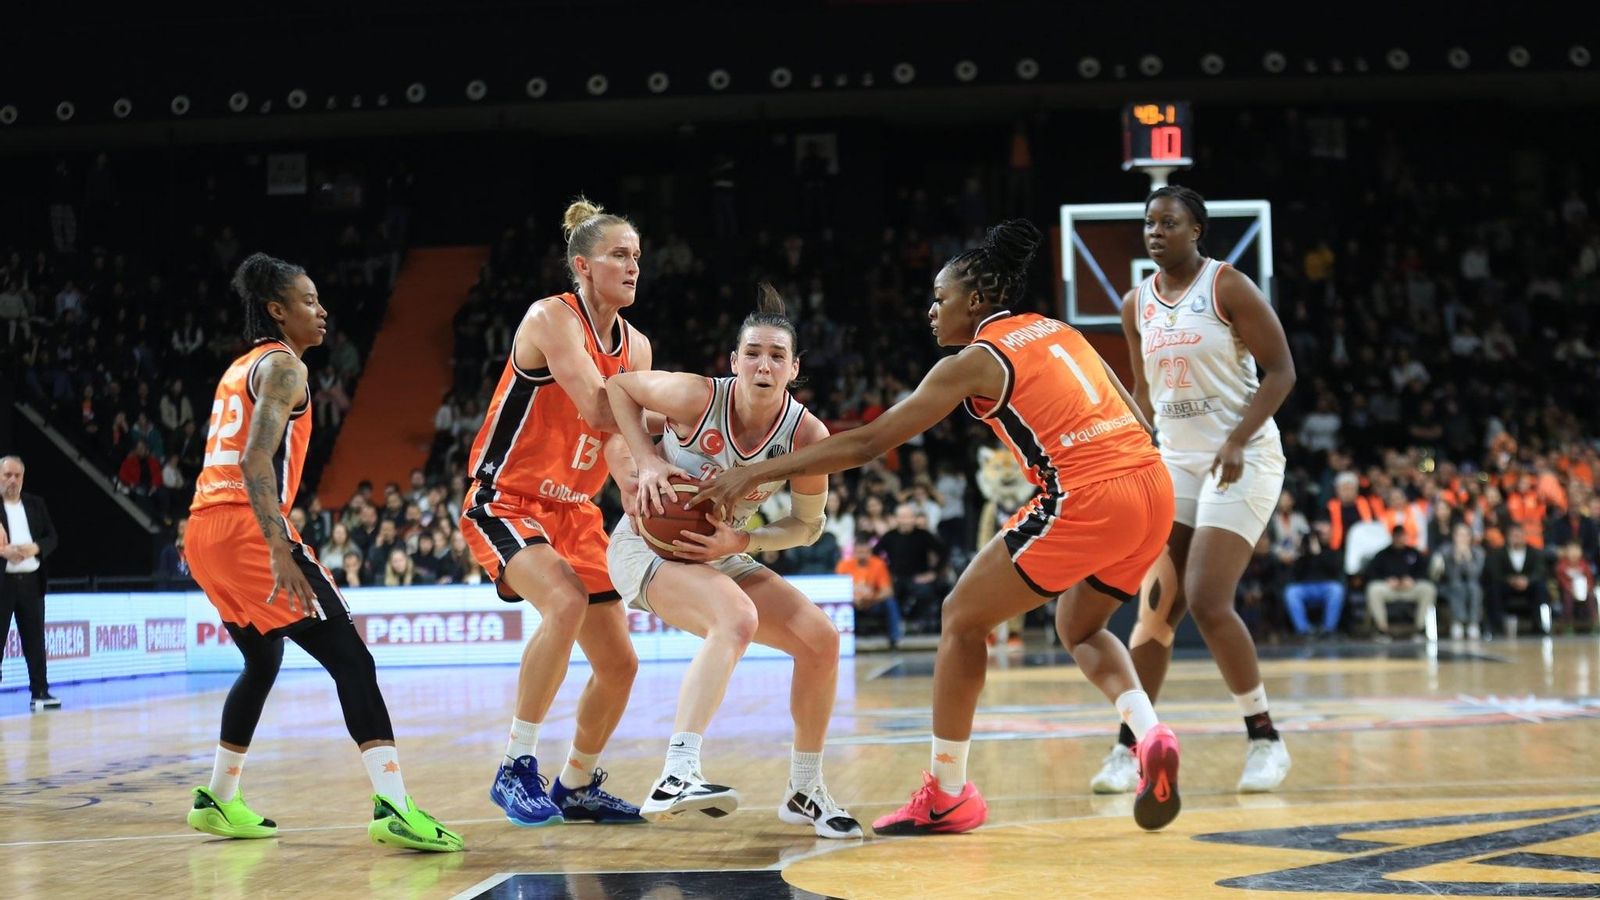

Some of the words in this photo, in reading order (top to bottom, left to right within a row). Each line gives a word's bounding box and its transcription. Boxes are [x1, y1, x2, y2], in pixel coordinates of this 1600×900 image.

[1151, 126, 1182, 160] 10
[1048, 343, 1101, 405] 1
[1160, 356, 1193, 389] 32
[571, 433, 603, 471] 13
[95, 624, 139, 652] PAMESA
[365, 612, 505, 644] PAMESA
